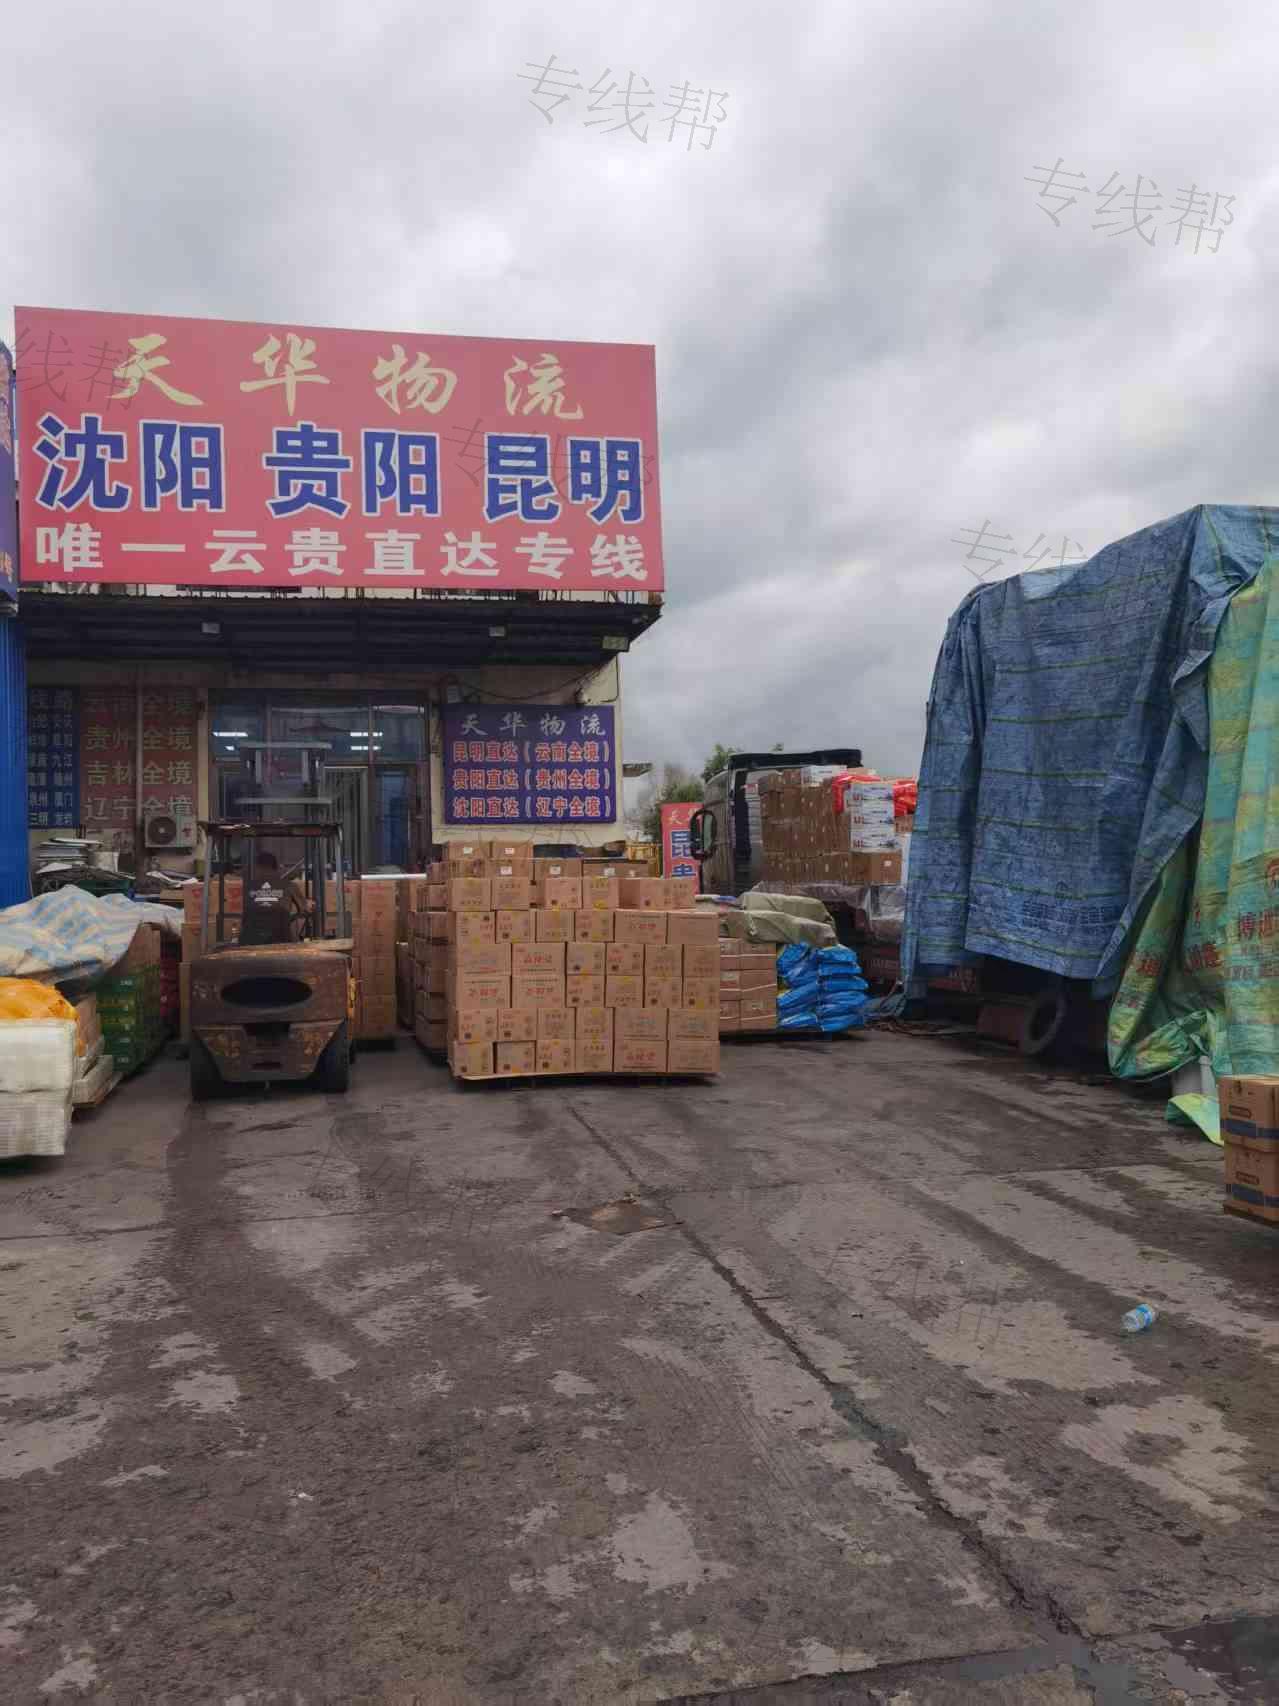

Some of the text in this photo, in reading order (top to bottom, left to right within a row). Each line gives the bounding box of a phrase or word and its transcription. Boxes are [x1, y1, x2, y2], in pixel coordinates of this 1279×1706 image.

[113, 333, 584, 420] 天华物流
[33, 413, 224, 513] 沈阳
[263, 421, 442, 518] 贵阳
[483, 431, 645, 524] 昆明
[35, 521, 648, 581] 唯一云贵直达专线
[461, 712, 606, 736] 天华物流
